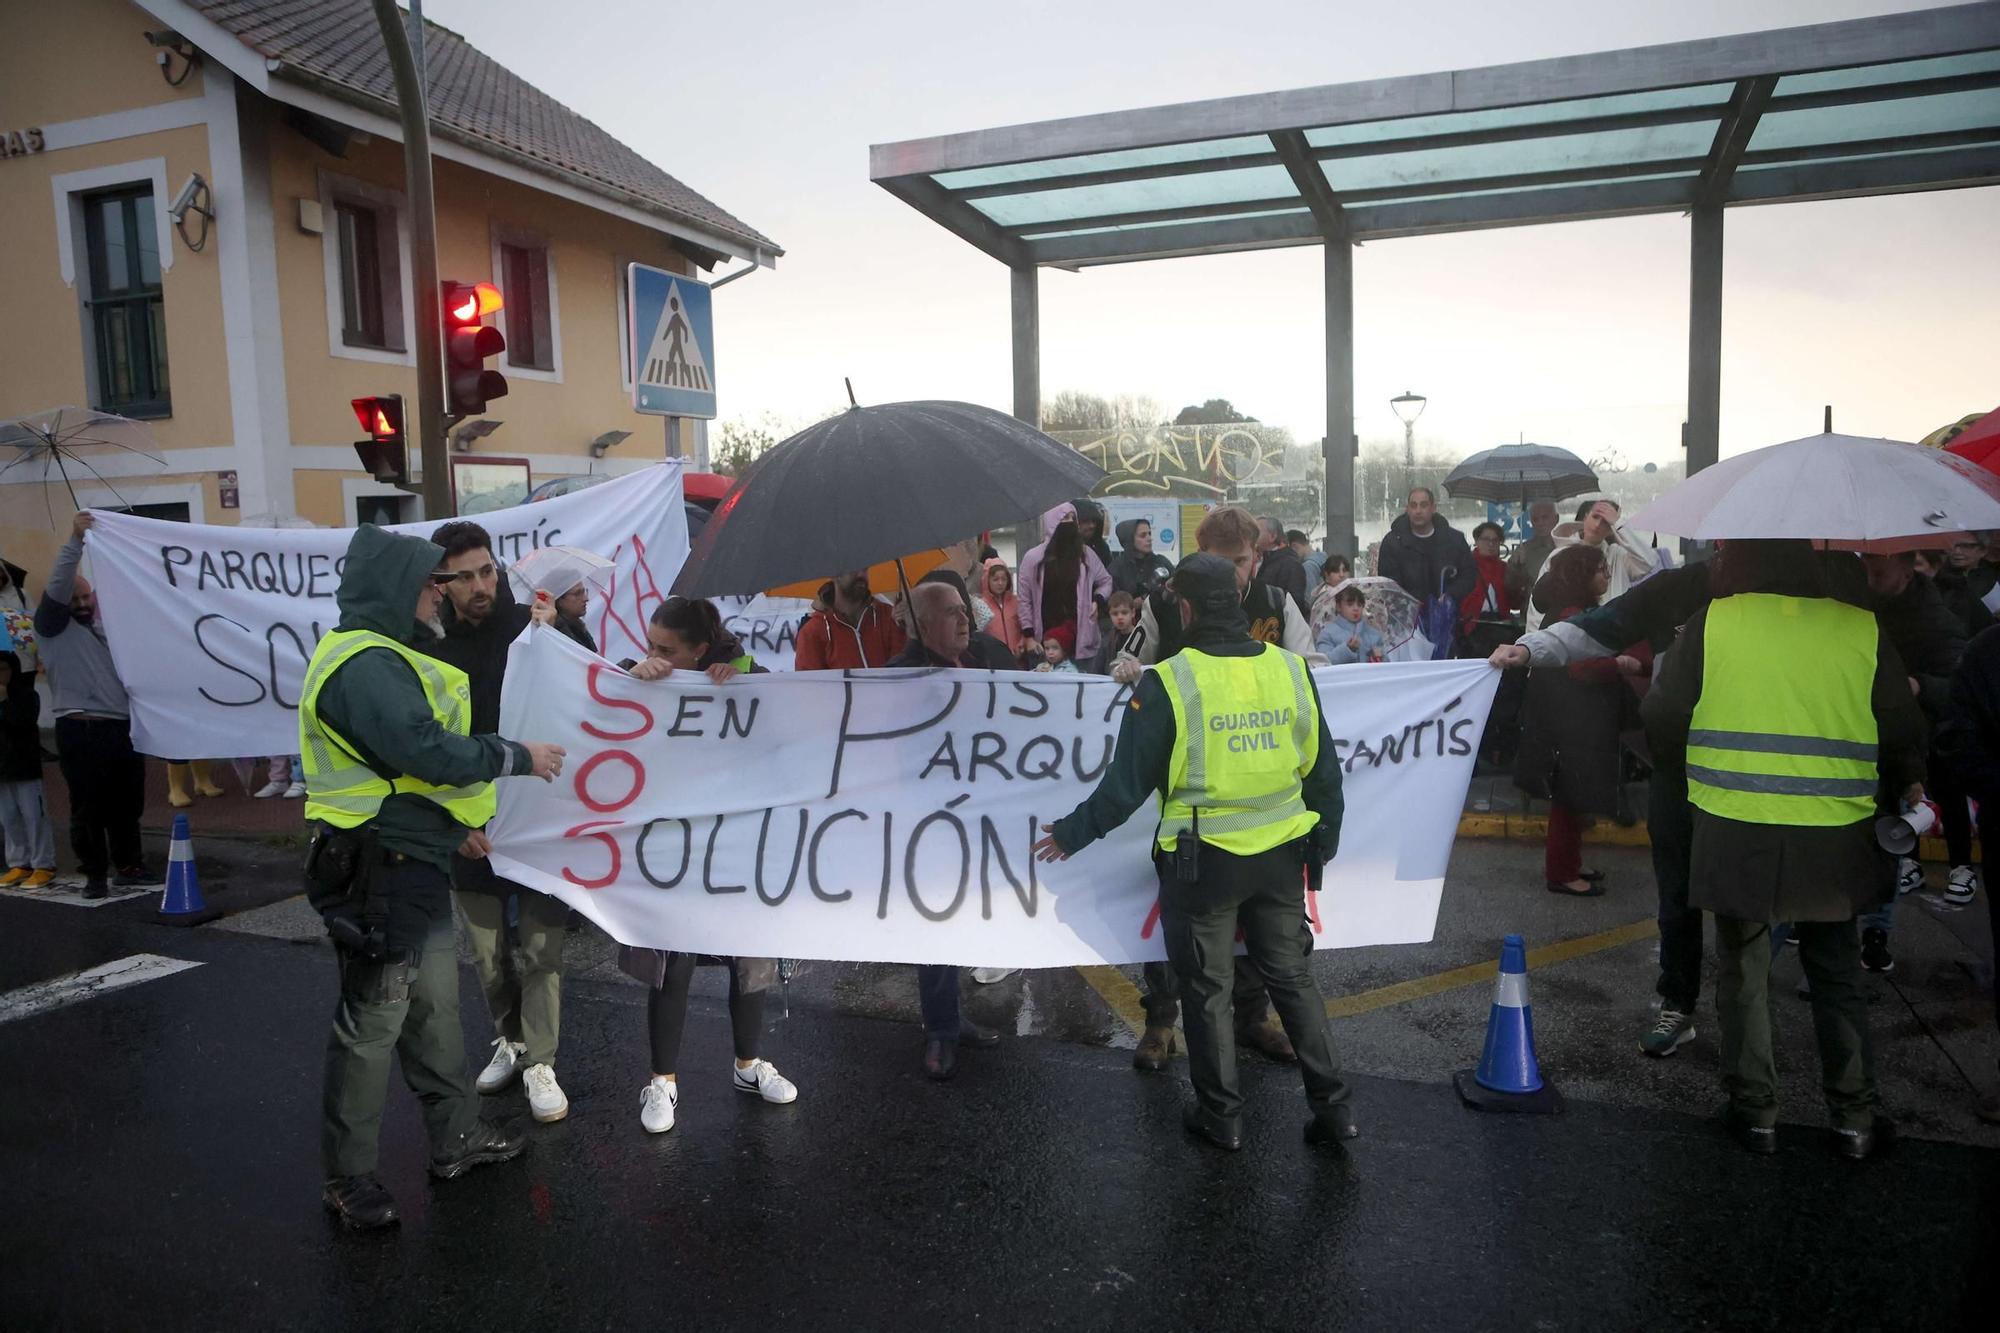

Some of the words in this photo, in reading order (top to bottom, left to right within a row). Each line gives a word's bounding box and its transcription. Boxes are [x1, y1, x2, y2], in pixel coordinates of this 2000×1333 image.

[194, 613, 321, 710] SO
[1209, 706, 1290, 733] GUARDIA
[1227, 733, 1280, 753] CIVIL
